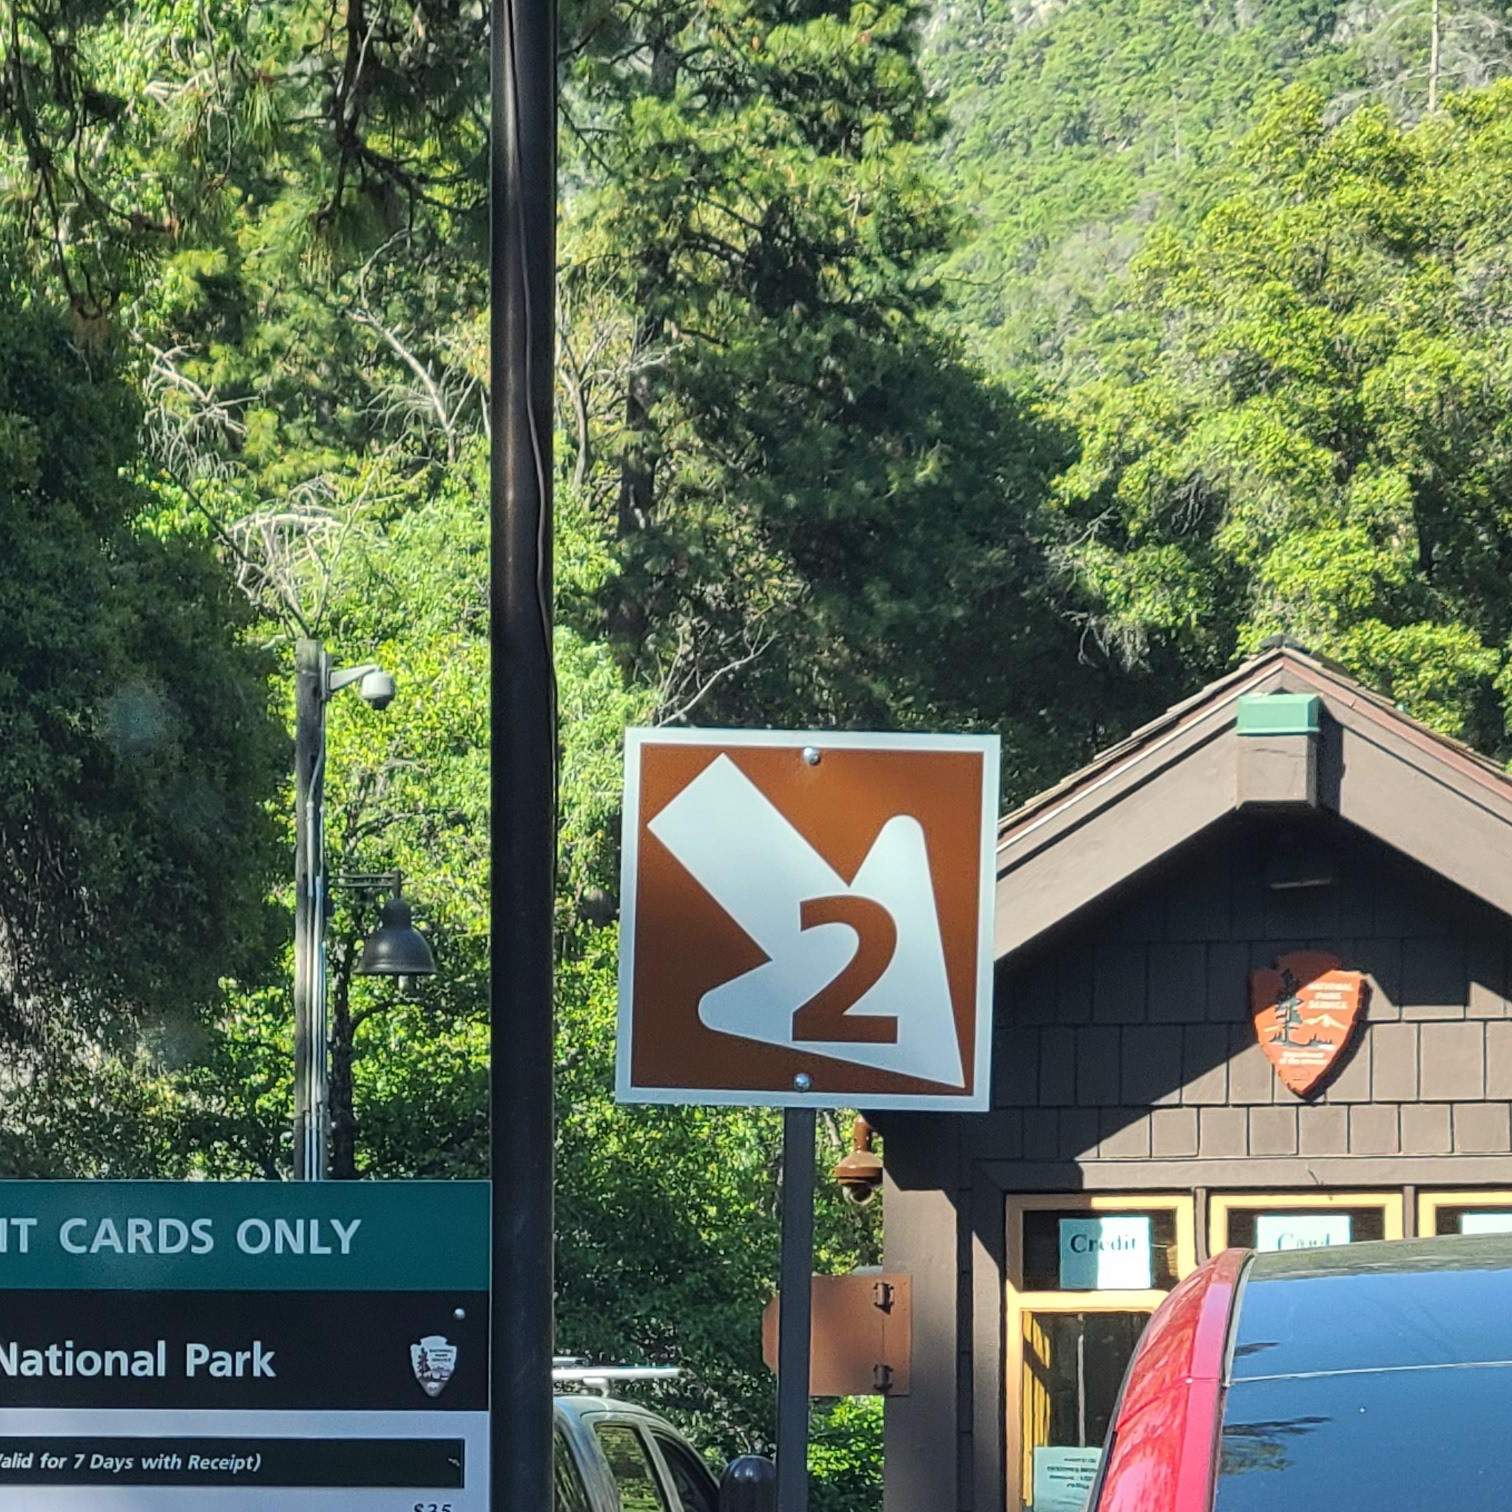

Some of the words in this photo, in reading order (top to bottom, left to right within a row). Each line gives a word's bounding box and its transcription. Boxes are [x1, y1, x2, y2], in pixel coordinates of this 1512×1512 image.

[792, 895, 898, 1043] 2
[59, 1218, 214, 1254] CARDS
[236, 1218, 361, 1255] ONLY
[1070, 1234, 1136, 1254] Credit
[185, 1340, 276, 1378] Park
[40, 1453, 67, 1469] for
[73, 1454, 84, 1470] 7
[90, 1455, 133, 1472] Days
[141, 1454, 182, 1471] with
[187, 1454, 261, 1473] Receipt)
